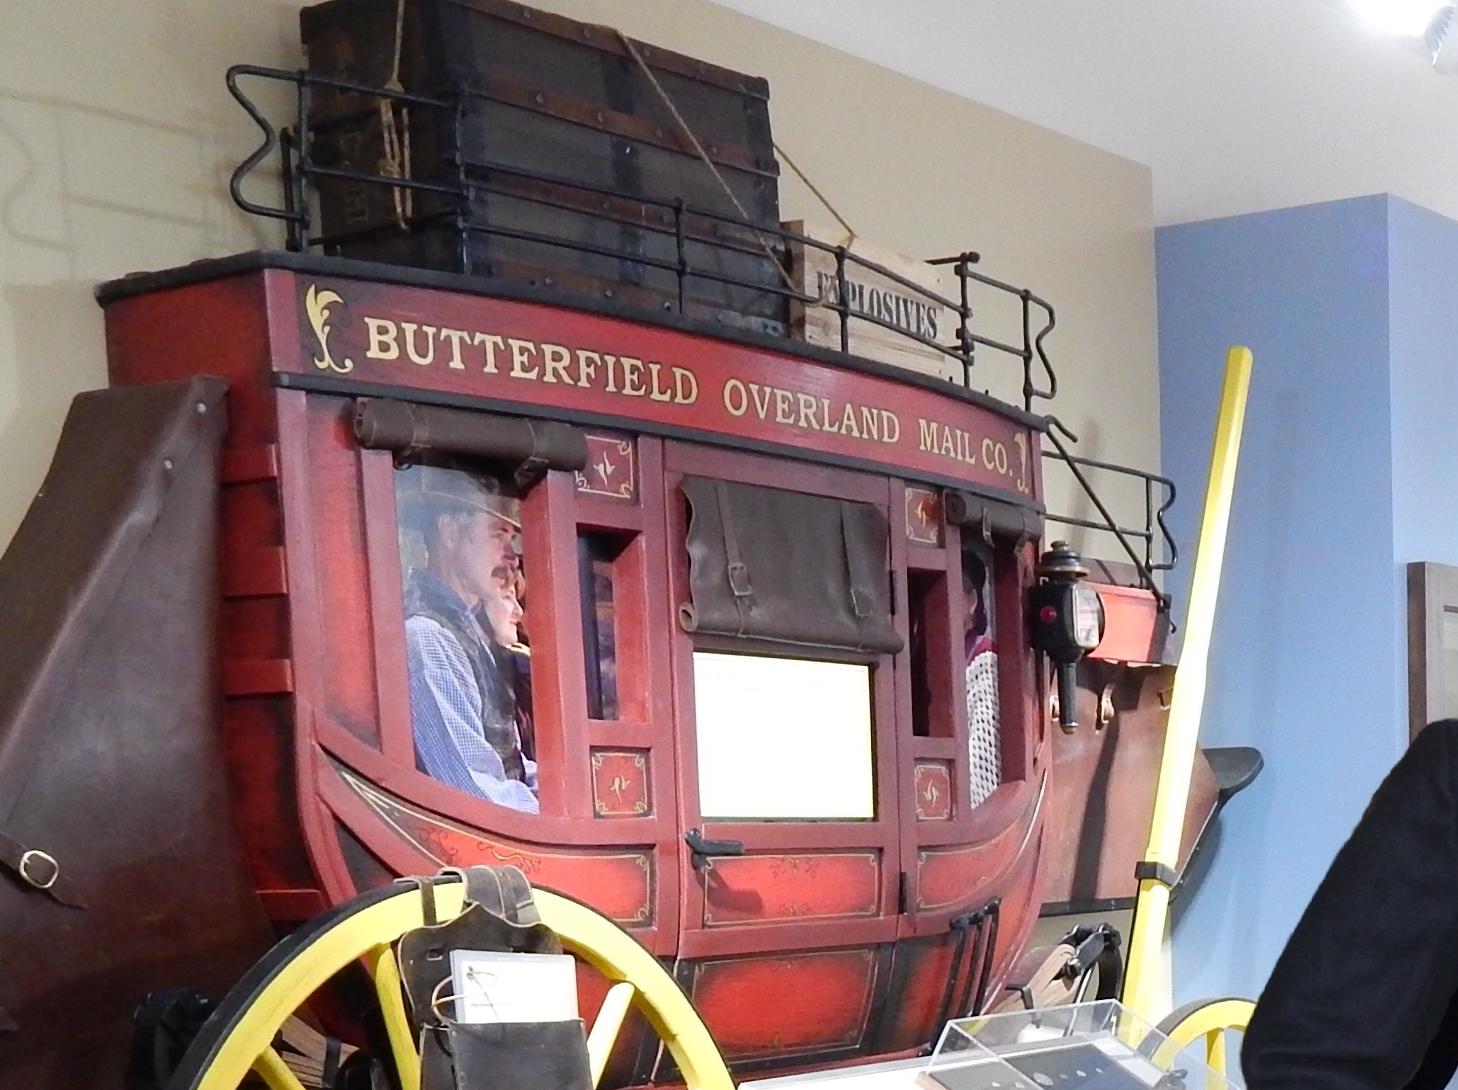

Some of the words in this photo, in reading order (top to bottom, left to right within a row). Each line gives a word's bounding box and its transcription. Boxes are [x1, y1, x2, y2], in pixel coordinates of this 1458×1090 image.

[363, 316, 699, 406] BUTTERFIELD
[722, 378, 901, 444] OVERLAND
[918, 418, 976, 465] MAIL
[981, 437, 1013, 477] CO.
